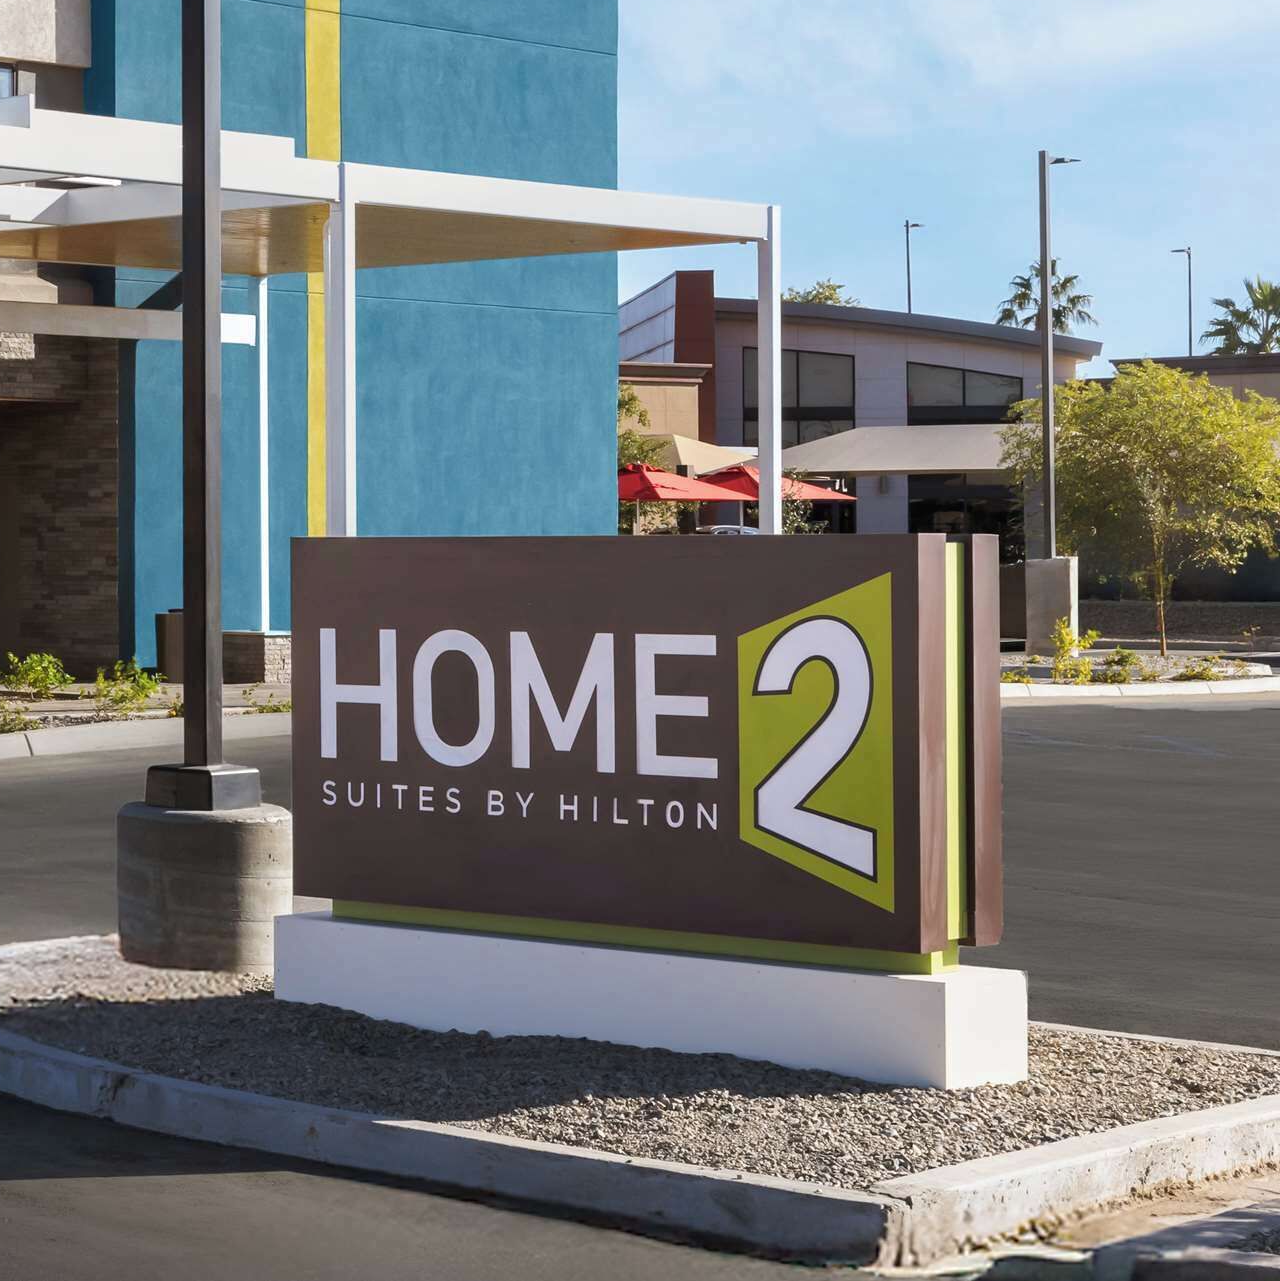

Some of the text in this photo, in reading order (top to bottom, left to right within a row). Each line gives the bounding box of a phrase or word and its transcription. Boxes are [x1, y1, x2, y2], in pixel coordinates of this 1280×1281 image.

[322, 780, 719, 830] SUITES BY HILTON
